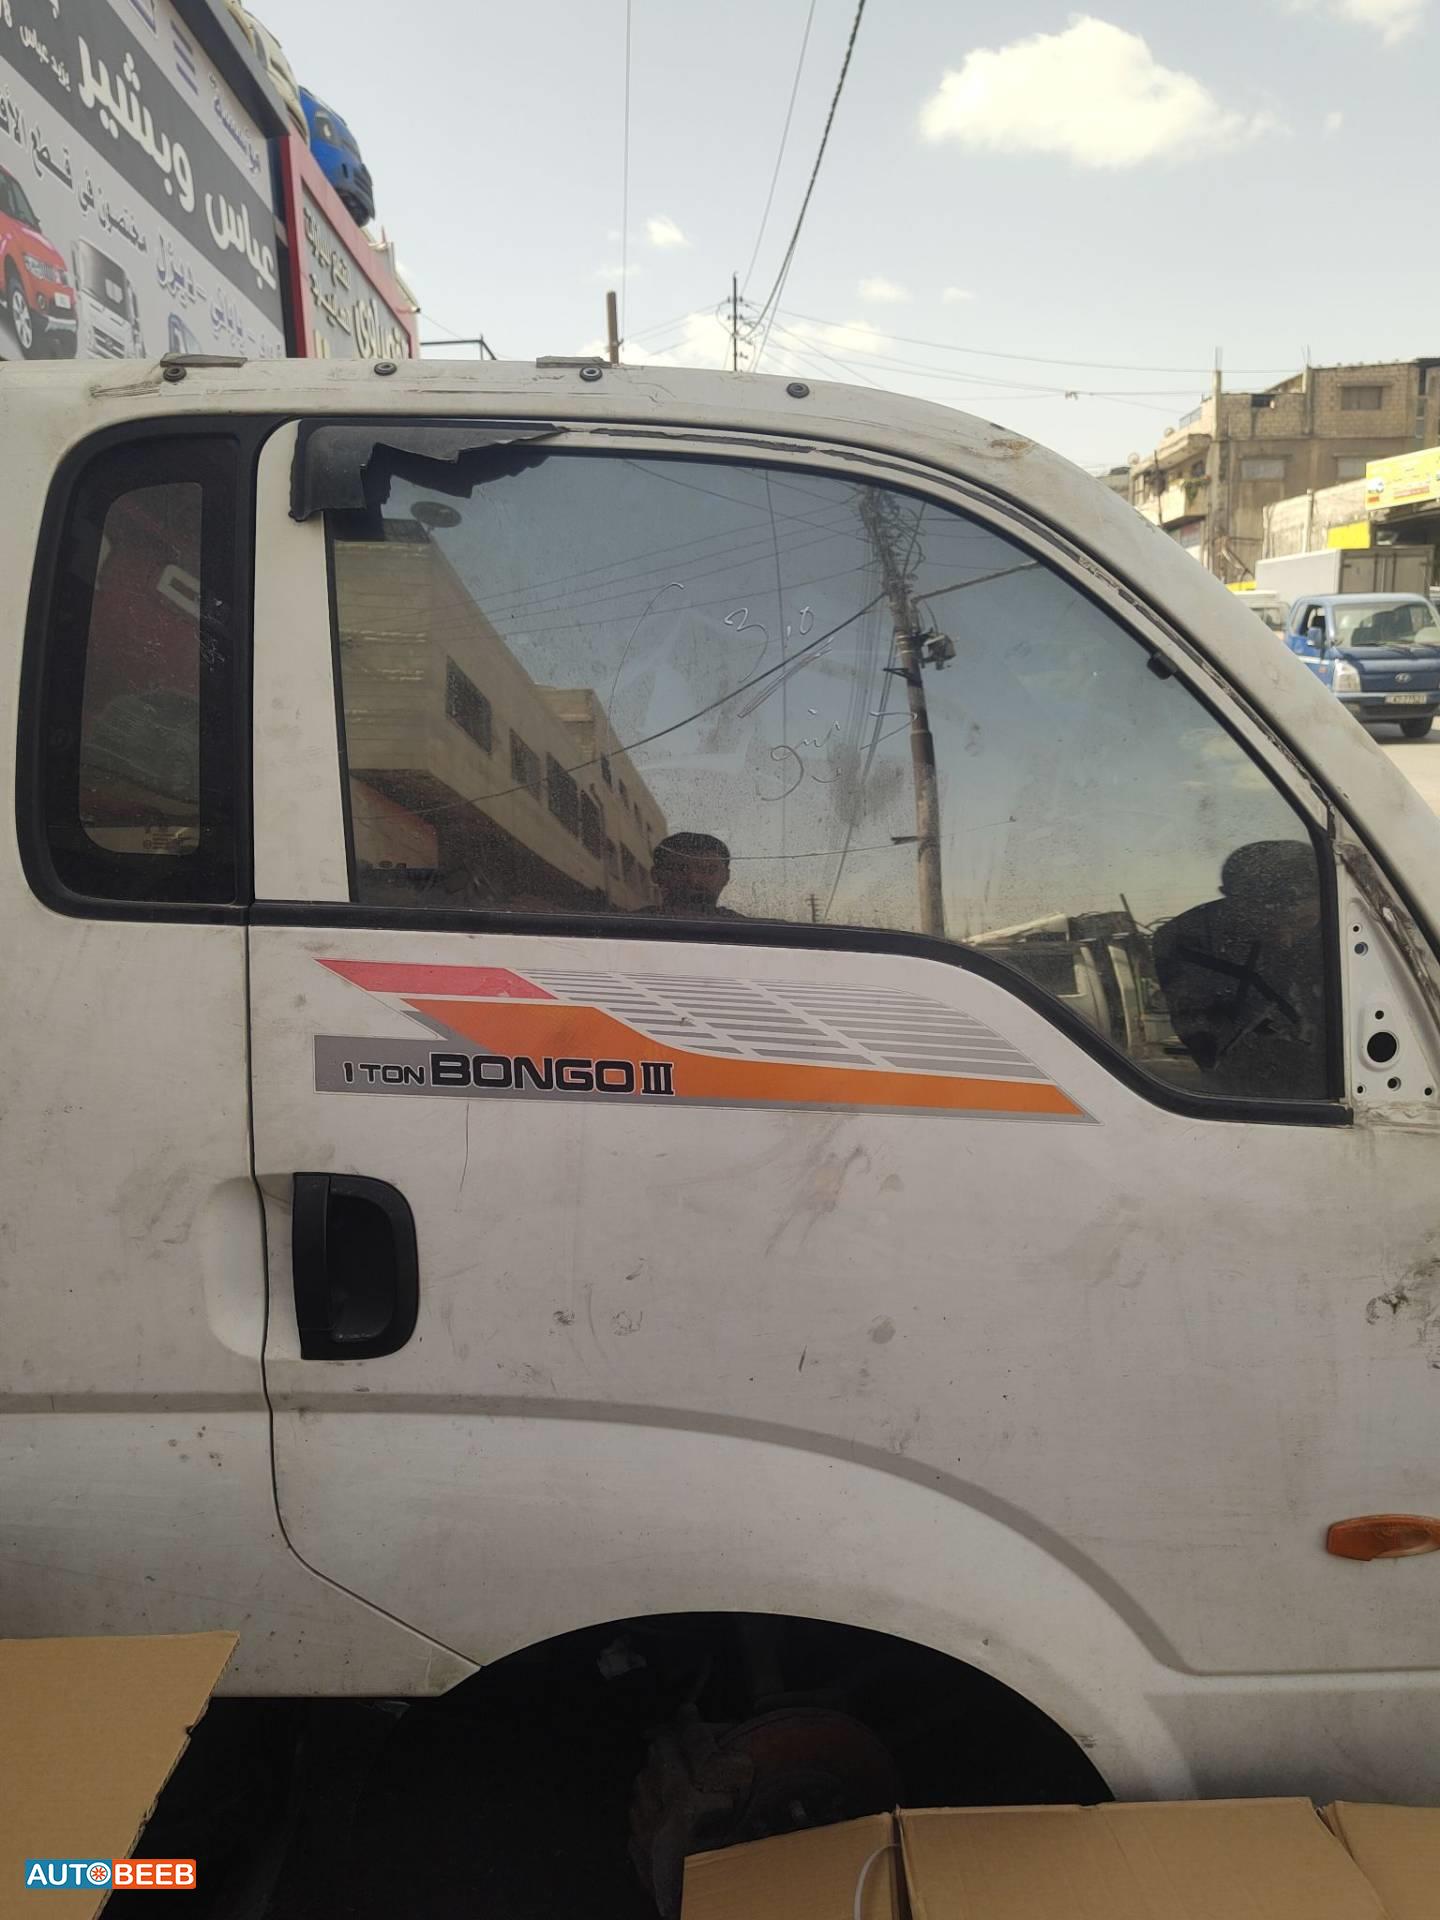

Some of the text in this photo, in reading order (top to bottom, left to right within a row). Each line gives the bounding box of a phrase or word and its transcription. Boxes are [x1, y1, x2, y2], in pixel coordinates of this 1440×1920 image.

[31, 123, 74, 191] قطع
[78, 35, 277, 290] عباس وبشير
[78, 168, 95, 217] في
[359, 1063, 425, 1085] TON
[430, 1052, 636, 1094] BONGO
[640, 1060, 675, 1096] III
